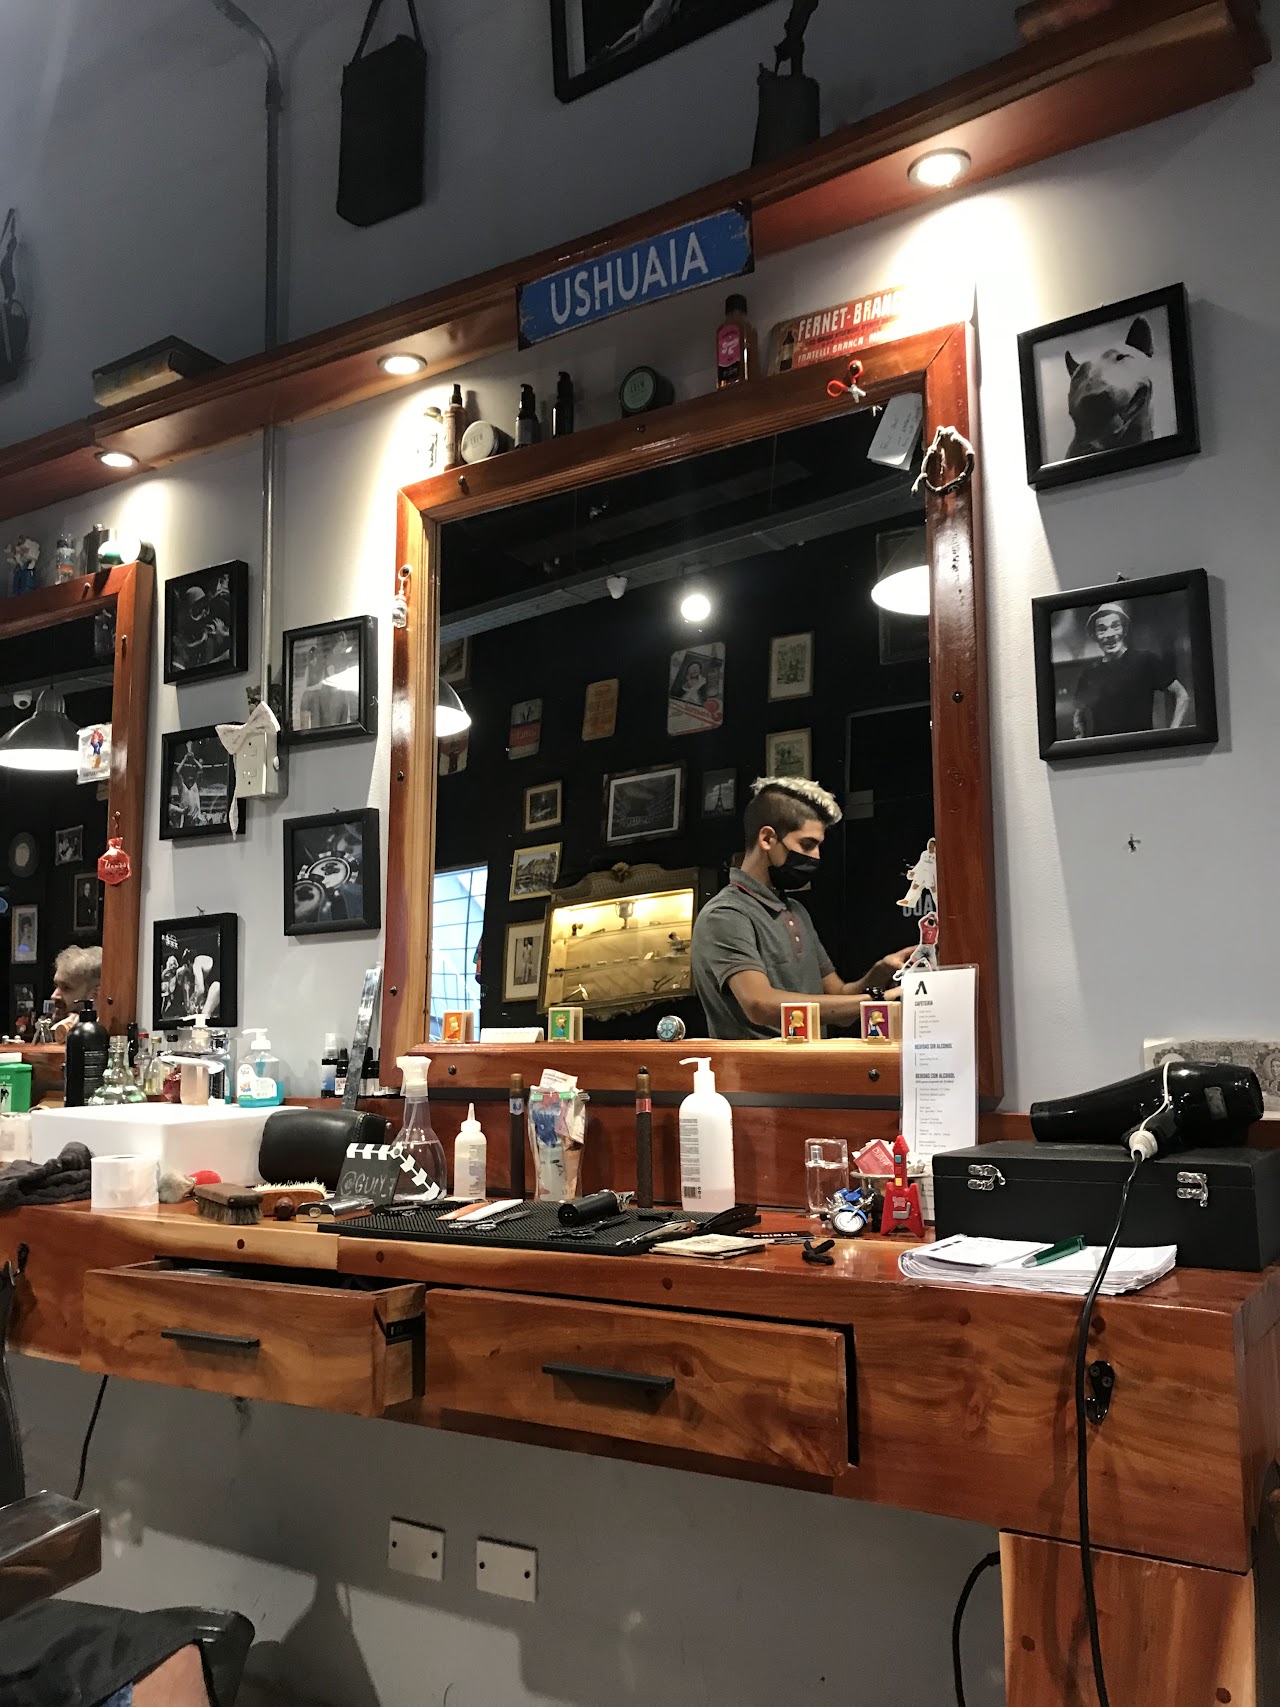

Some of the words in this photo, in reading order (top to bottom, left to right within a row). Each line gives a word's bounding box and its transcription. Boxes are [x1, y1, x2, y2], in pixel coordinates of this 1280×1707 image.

[549, 231, 709, 325] USHUAIA
[797, 290, 903, 341] FERNET-BRAN
[832, 336, 864, 354] BRANCA
